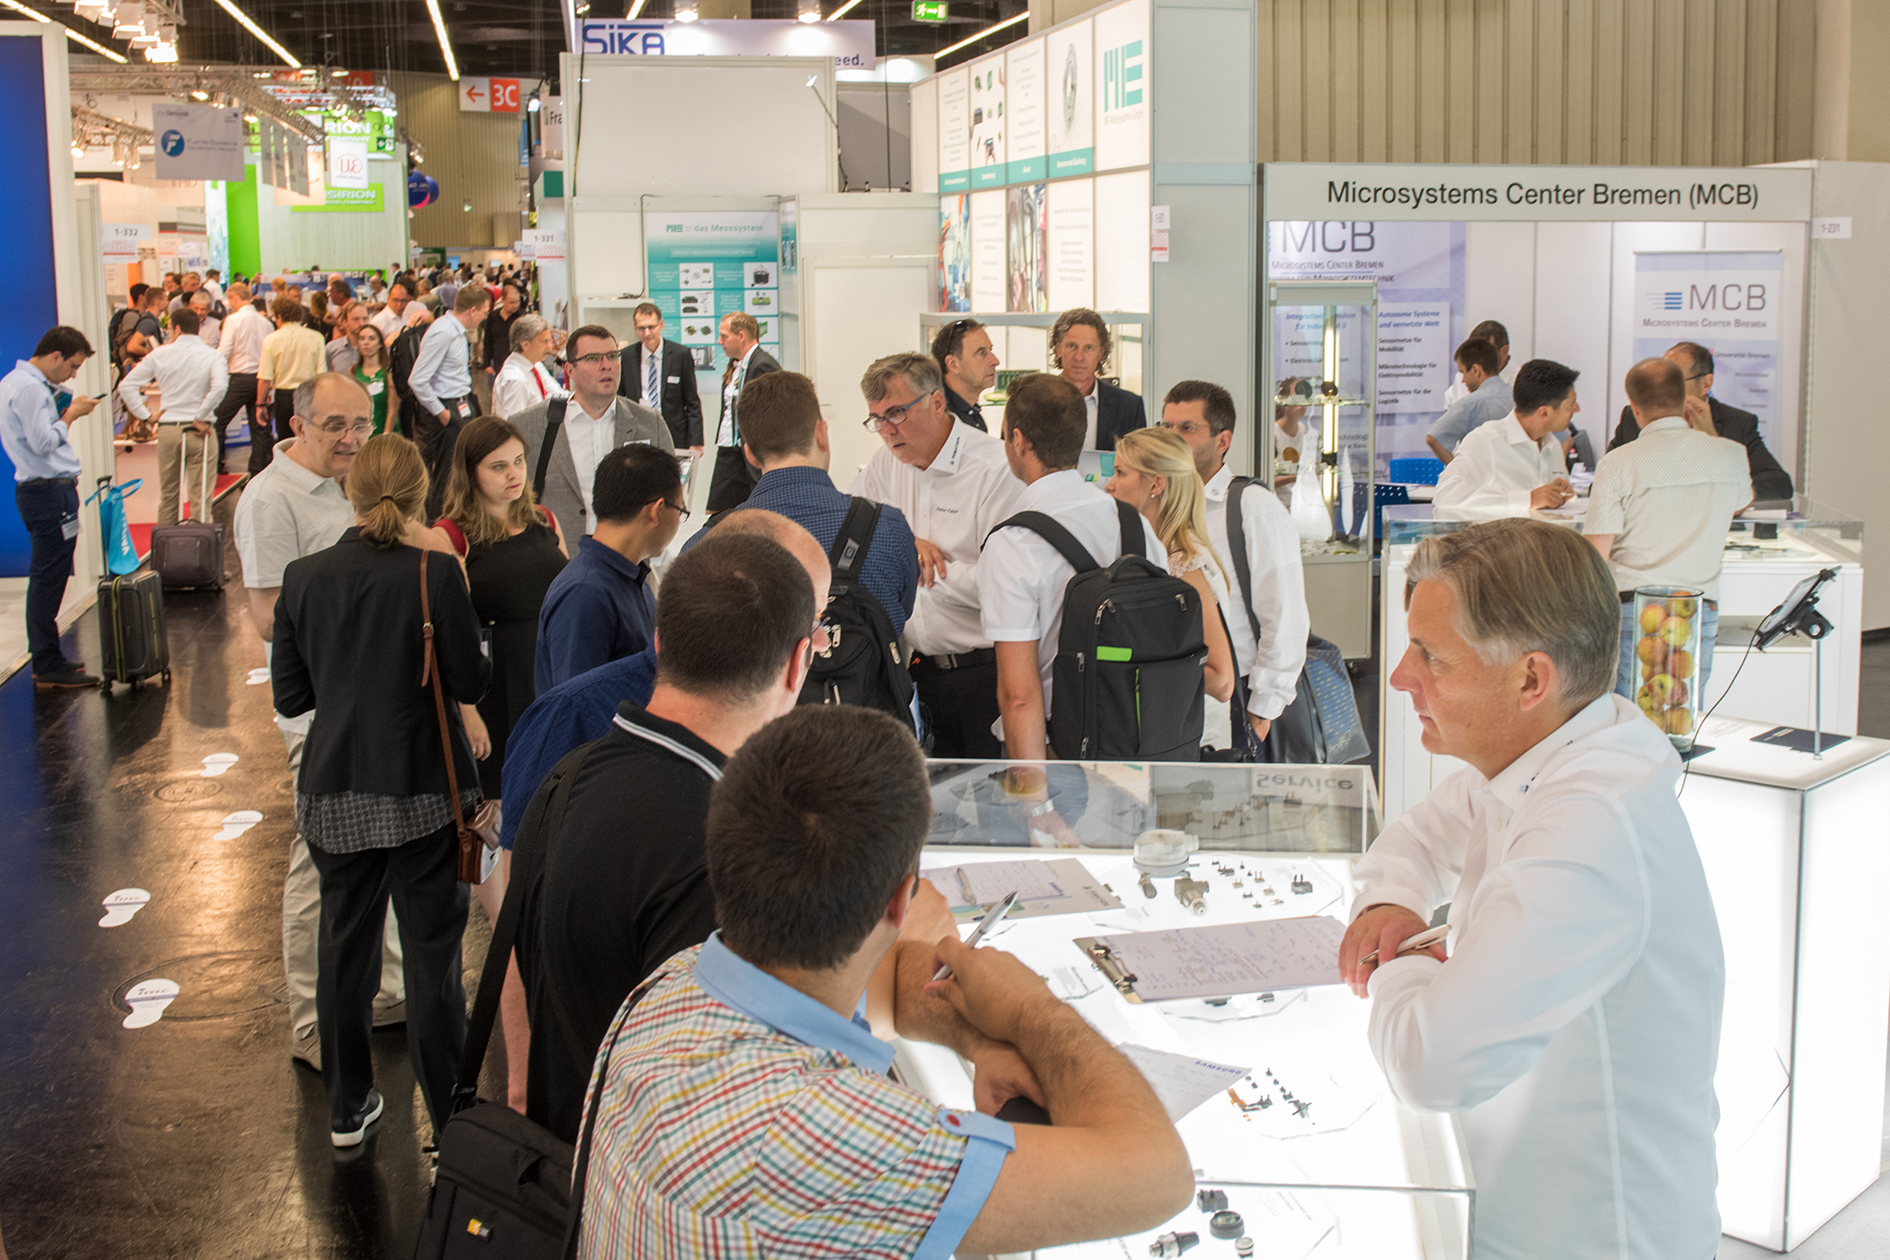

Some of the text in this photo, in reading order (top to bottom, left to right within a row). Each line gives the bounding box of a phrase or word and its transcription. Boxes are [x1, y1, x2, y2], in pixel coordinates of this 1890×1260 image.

[493, 84, 518, 107] 3C
[1327, 181, 1759, 210] Microsystems Center Bremen (MCB)
[115, 228, 138, 236] 1-332
[1282, 221, 1376, 253] MCB
[1821, 223, 1841, 234] 1-231
[1690, 284, 1767, 311] MCB
